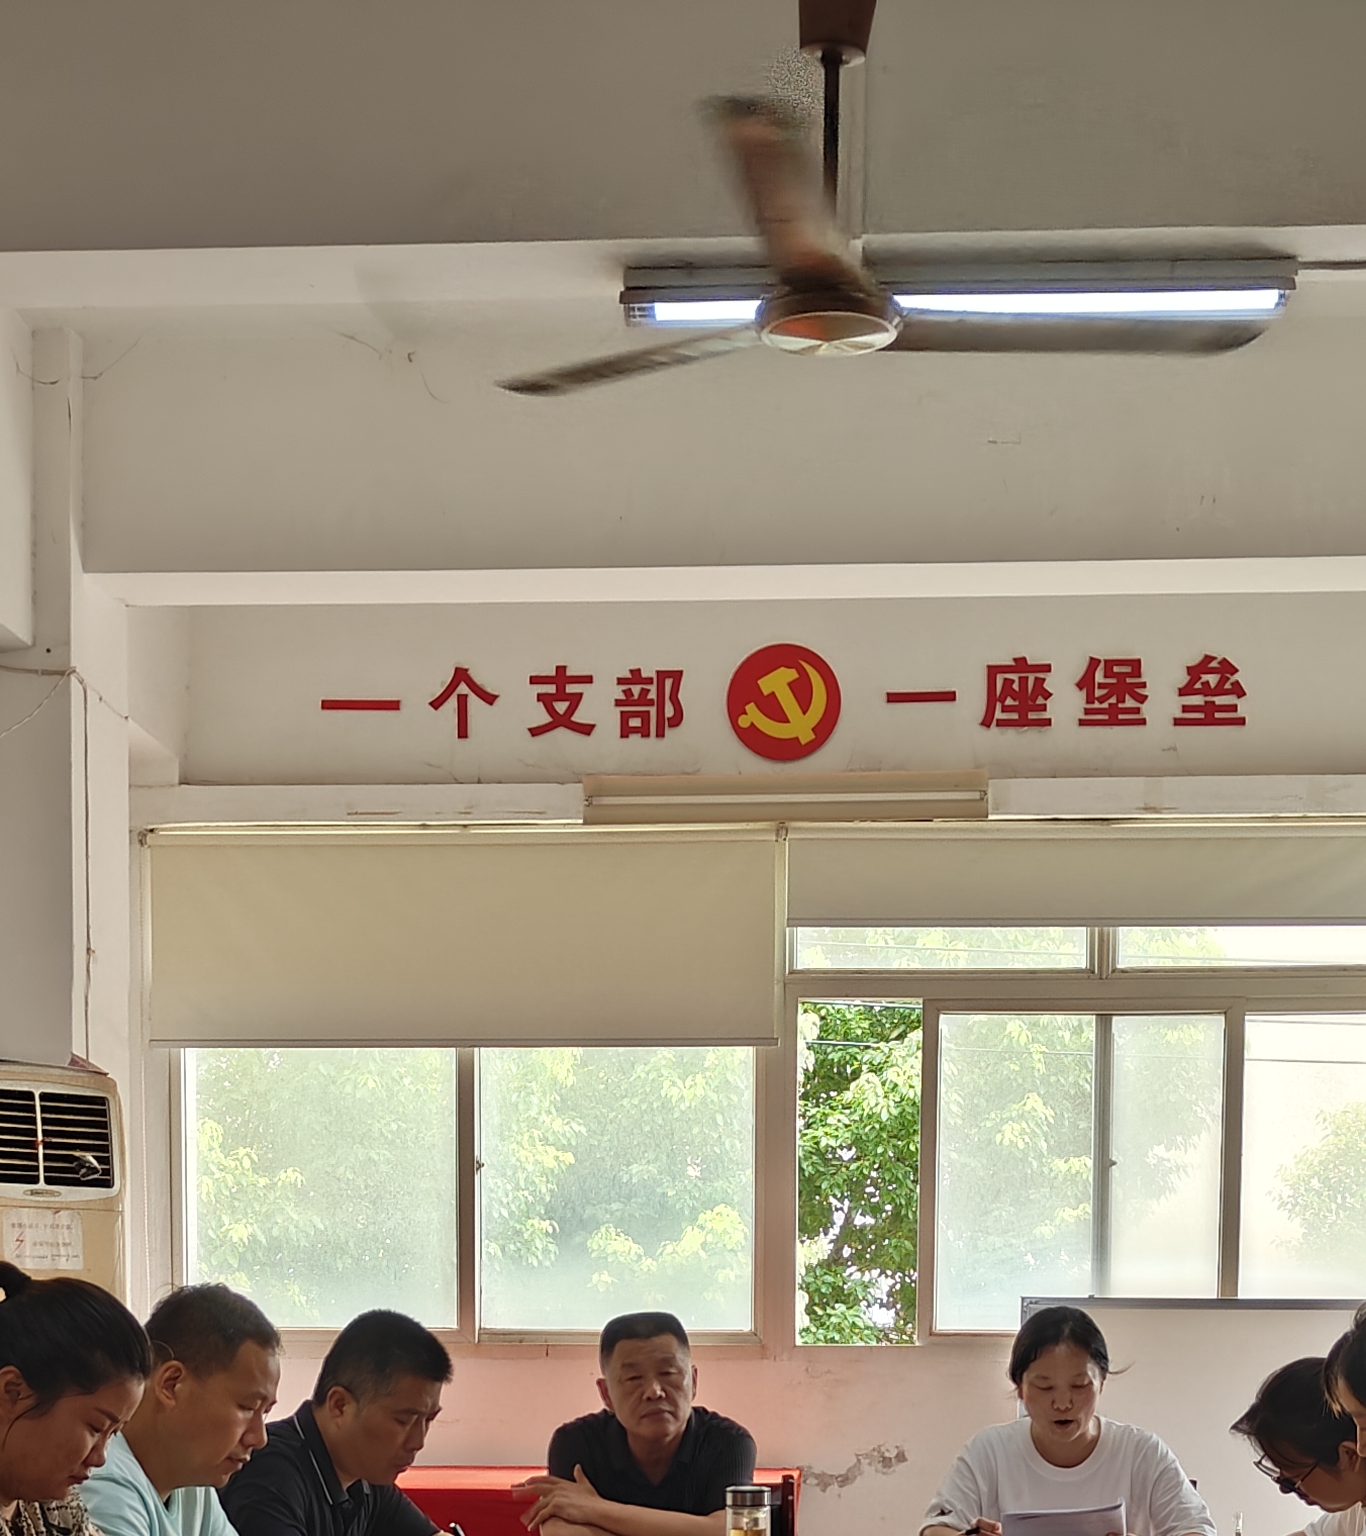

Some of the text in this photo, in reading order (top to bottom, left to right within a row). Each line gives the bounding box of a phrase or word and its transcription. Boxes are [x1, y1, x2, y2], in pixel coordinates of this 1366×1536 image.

[321, 654, 1249, 740] 一个支部 一座堡垒
